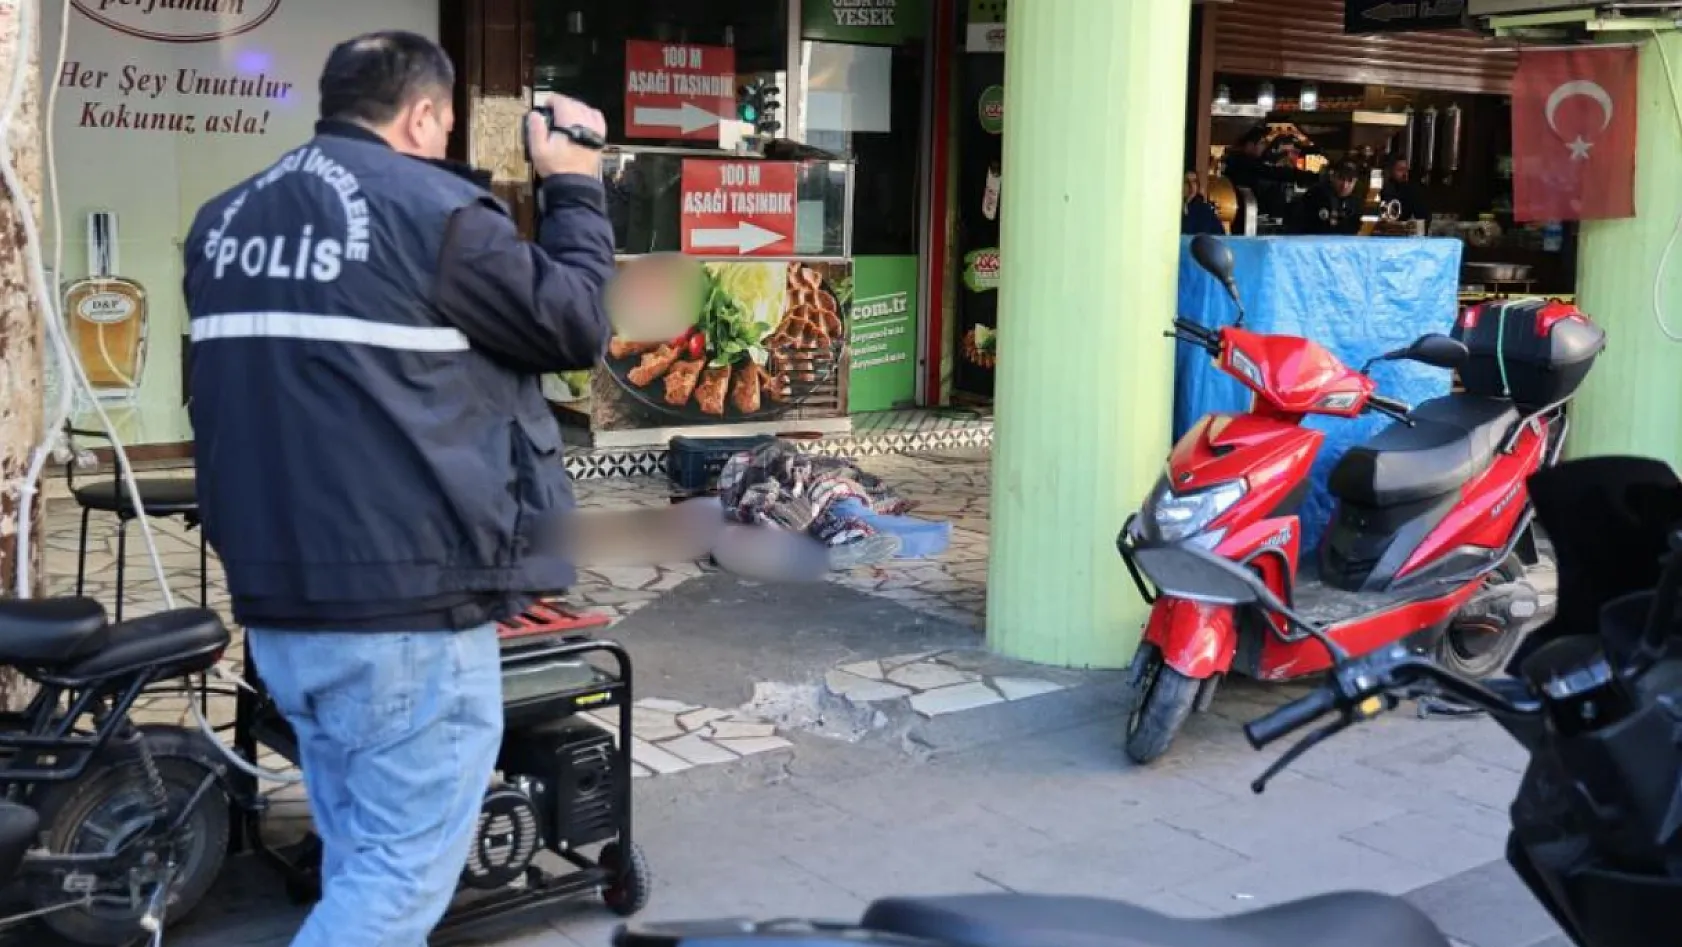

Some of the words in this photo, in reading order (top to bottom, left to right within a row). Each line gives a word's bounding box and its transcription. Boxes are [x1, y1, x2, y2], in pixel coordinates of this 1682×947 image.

[832, 7, 896, 26] YESEK
[662, 46, 686, 68] 100
[690, 47, 703, 69] M
[59, 61, 109, 89] Her
[118, 64, 168, 98] Şey
[176, 67, 293, 98] Unutulur
[628, 68, 670, 96] AŞAĞI
[80, 101, 196, 134] Kokunuz
[205, 109, 270, 135] asla!
[720, 162, 746, 186] 100
[748, 163, 760, 186] M
[684, 187, 728, 218] AŞAĞI
[730, 191, 792, 218] TAŞINDIK
[213, 224, 342, 283] POLİS
